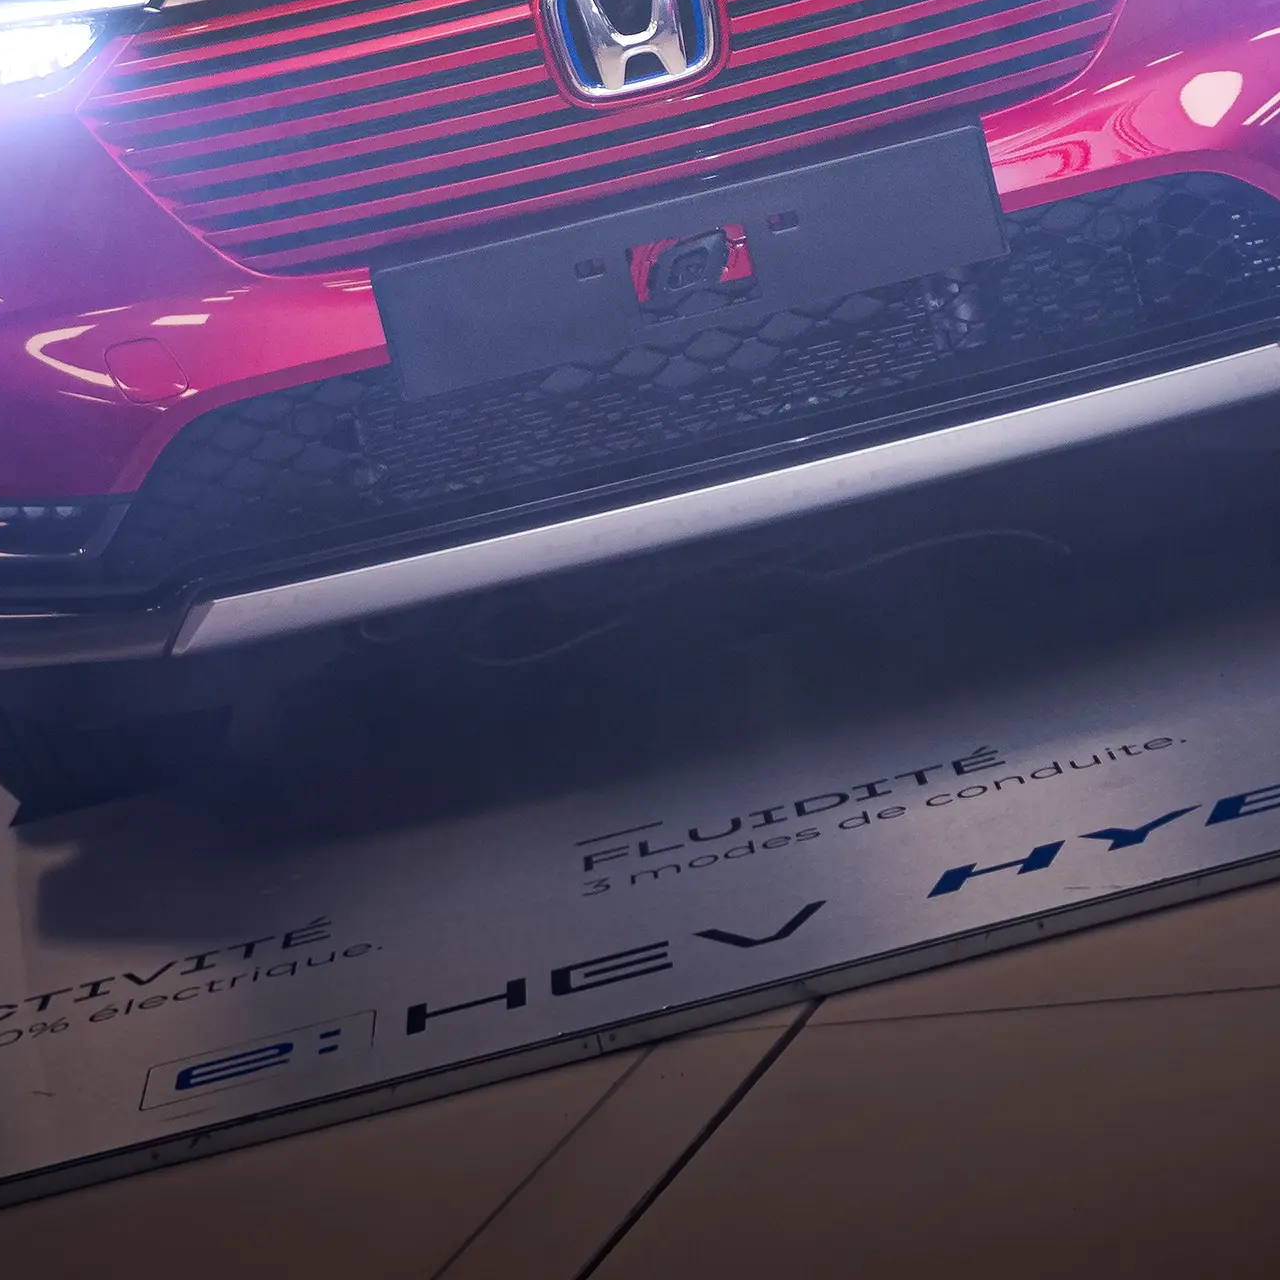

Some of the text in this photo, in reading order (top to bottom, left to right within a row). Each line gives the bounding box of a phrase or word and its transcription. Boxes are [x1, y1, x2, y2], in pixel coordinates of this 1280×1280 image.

[581, 732, 1188, 898] 3 modes de conduite.
[582, 746, 1007, 872] FLUIDITÉ
[88, 942, 383, 1024] électrique.
